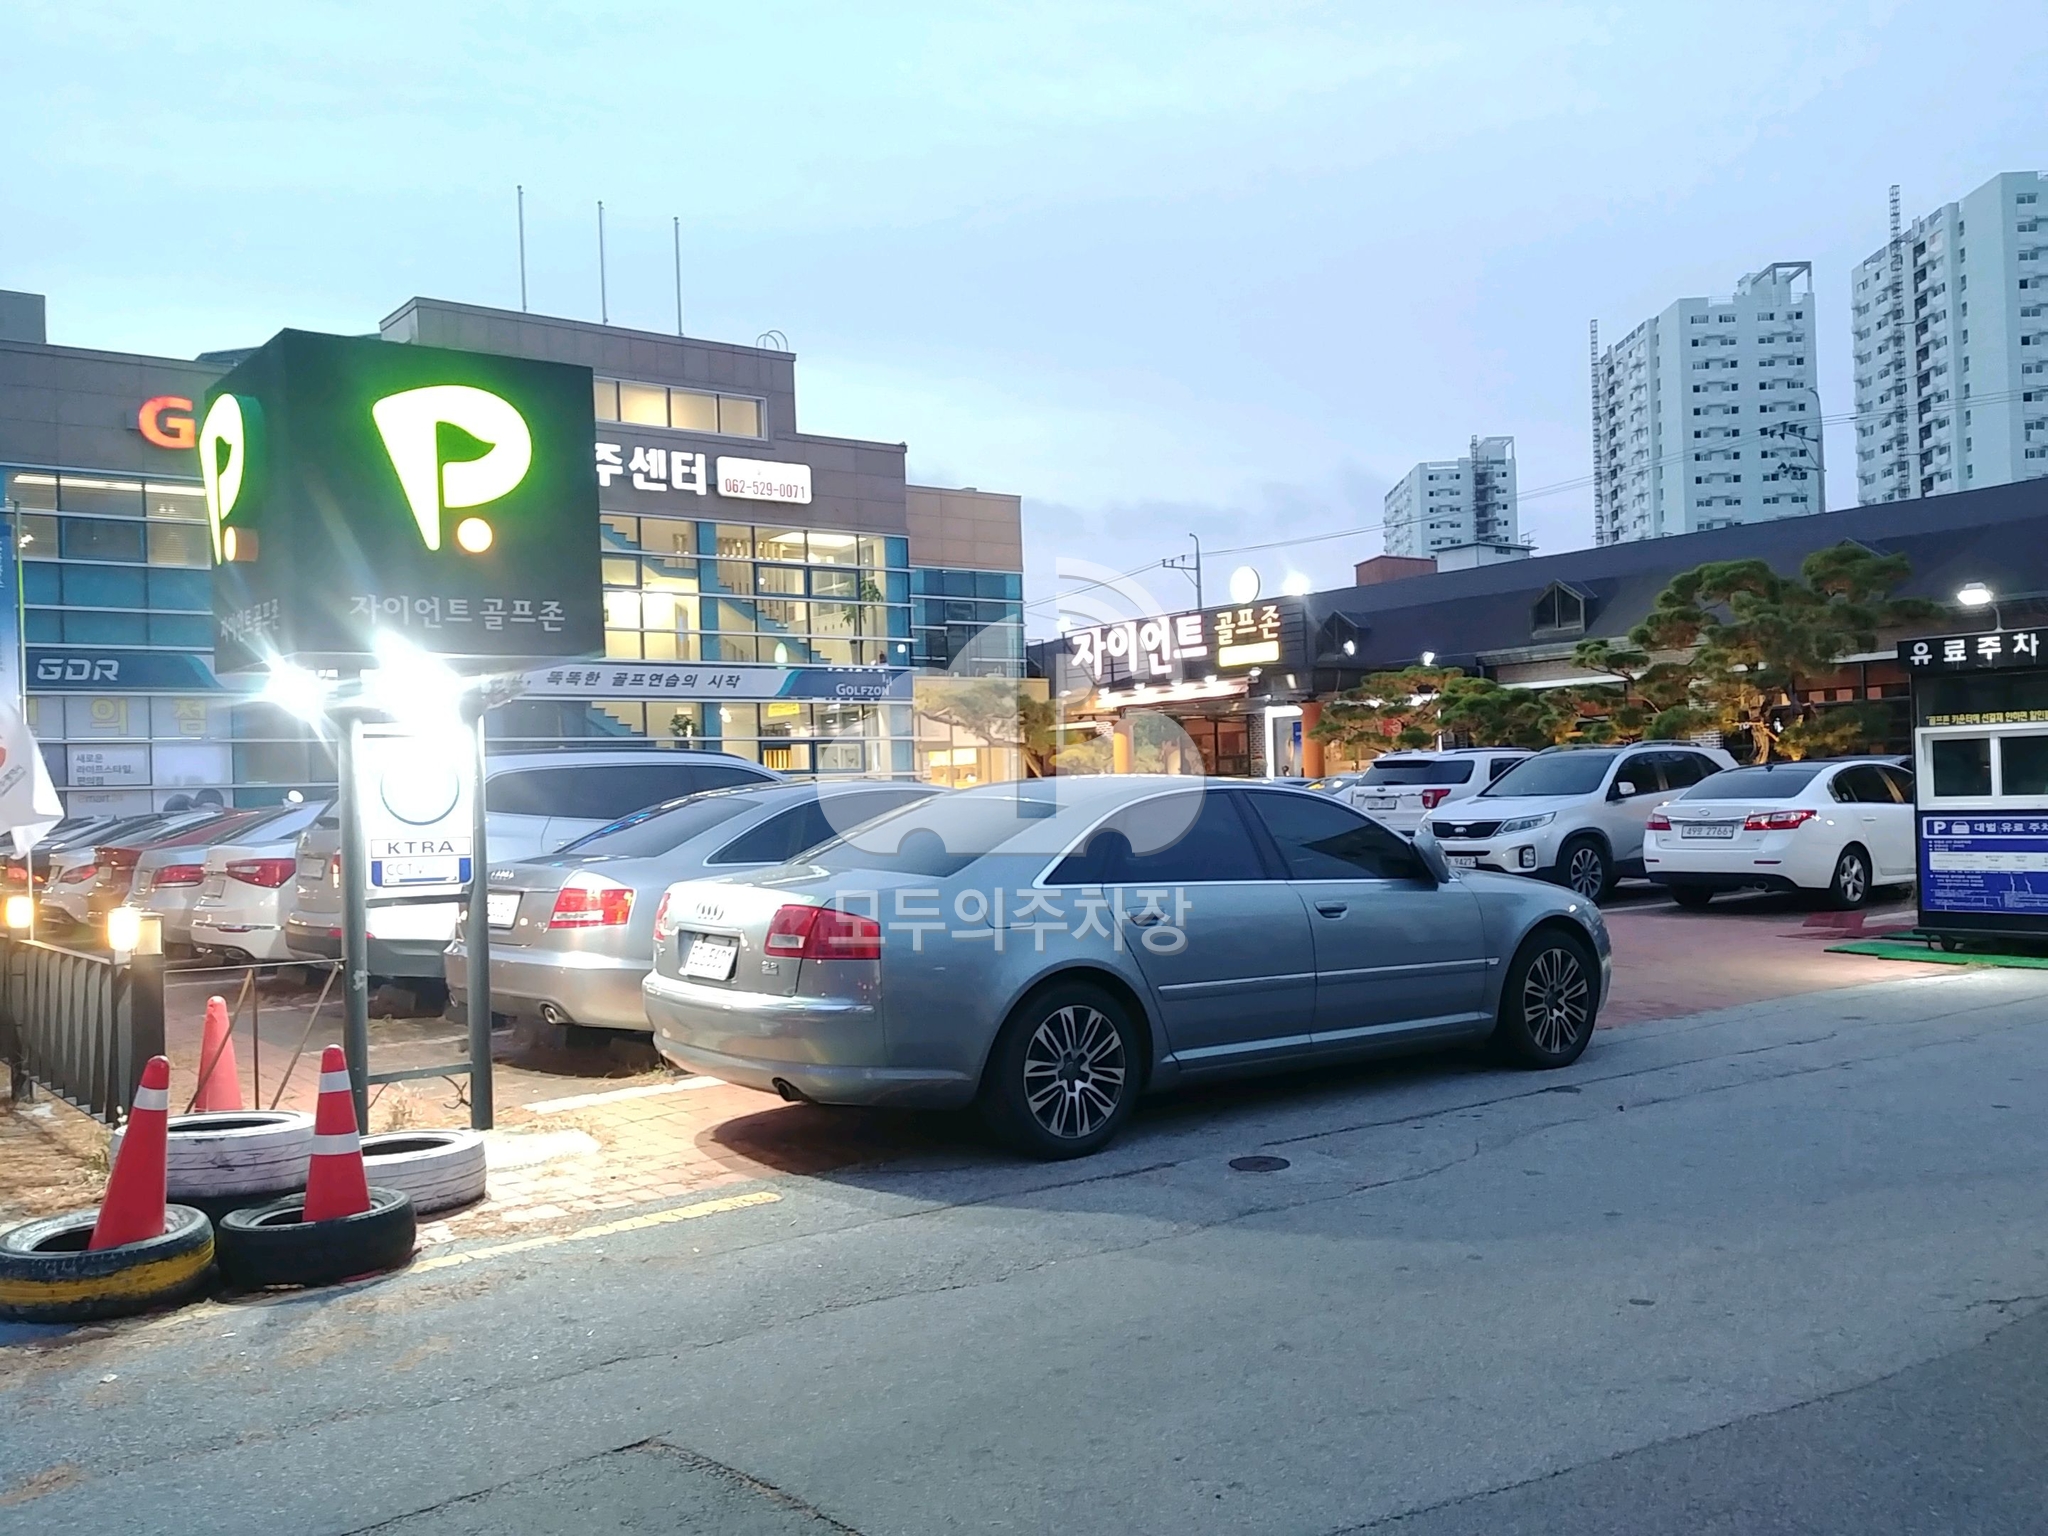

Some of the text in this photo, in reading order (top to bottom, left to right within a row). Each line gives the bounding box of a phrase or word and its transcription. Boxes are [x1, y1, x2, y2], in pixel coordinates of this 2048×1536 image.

[724, 478, 805, 499] 062-529-0071
[350, 594, 565, 632] 자이언트 골프존
[1071, 605, 1281, 681] 자이언트 골프존
[37, 658, 119, 681] GDR
[546, 671, 601, 686] 똑똑한
[612, 671, 698, 689] 골프연습의
[706, 675, 742, 689] 시작
[388, 841, 454, 854] KTRA
